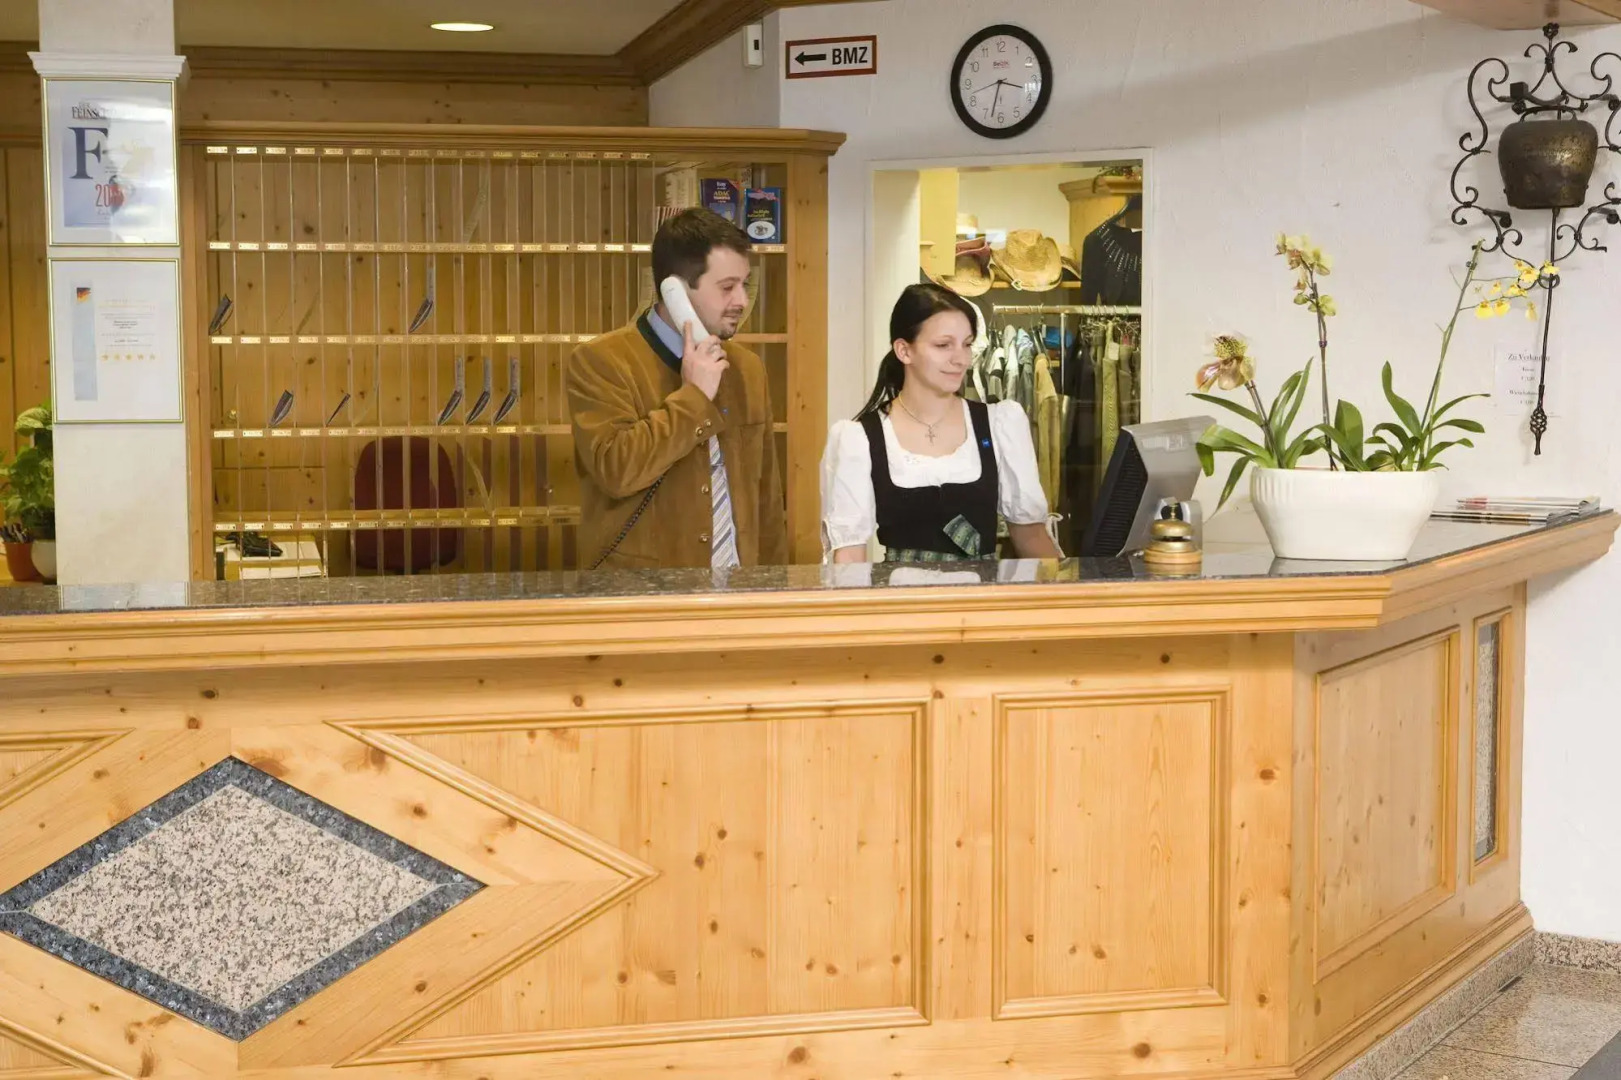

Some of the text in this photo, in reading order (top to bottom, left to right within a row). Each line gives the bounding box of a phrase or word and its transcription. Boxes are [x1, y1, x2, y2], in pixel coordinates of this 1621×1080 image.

[996, 41, 1006, 53] 12
[831, 46, 868, 65] BMZ
[981, 48, 989, 58] 11
[970, 61, 979, 73] 10
[965, 79, 972, 90] 9
[969, 96, 977, 107] 8
[982, 108, 989, 119] 7
[997, 112, 1005, 124] 6
[1013, 107, 1020, 118] 5
